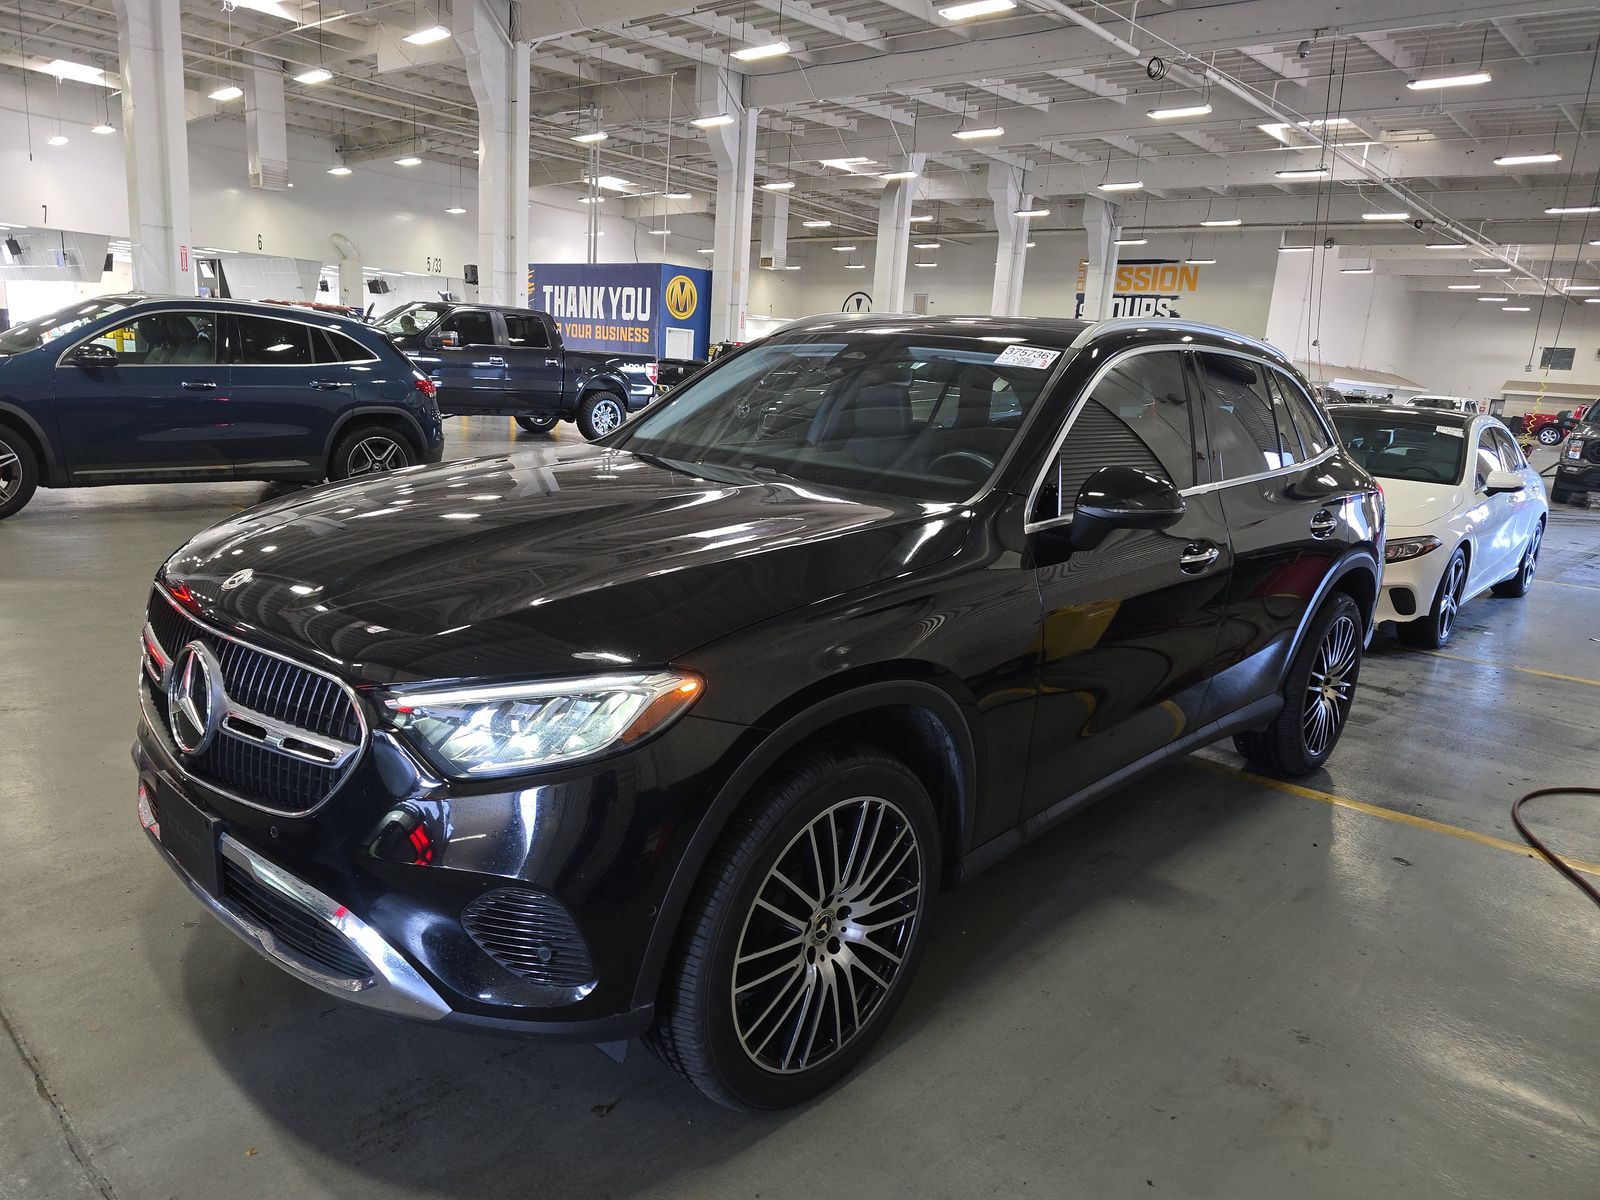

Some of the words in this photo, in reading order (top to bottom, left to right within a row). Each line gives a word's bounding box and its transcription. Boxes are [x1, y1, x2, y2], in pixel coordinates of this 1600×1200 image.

[42, 204, 47, 224] 7
[257, 234, 262, 251] 6
[1116, 266, 1199, 292] SSION
[543, 285, 605, 319] THANK
[608, 286, 651, 321] YOU
[1109, 298, 1172, 317] OURS
[565, 323, 592, 339] YOUR
[595, 325, 649, 343] BUSINESS
[1005, 347, 1057, 360] 3757361
